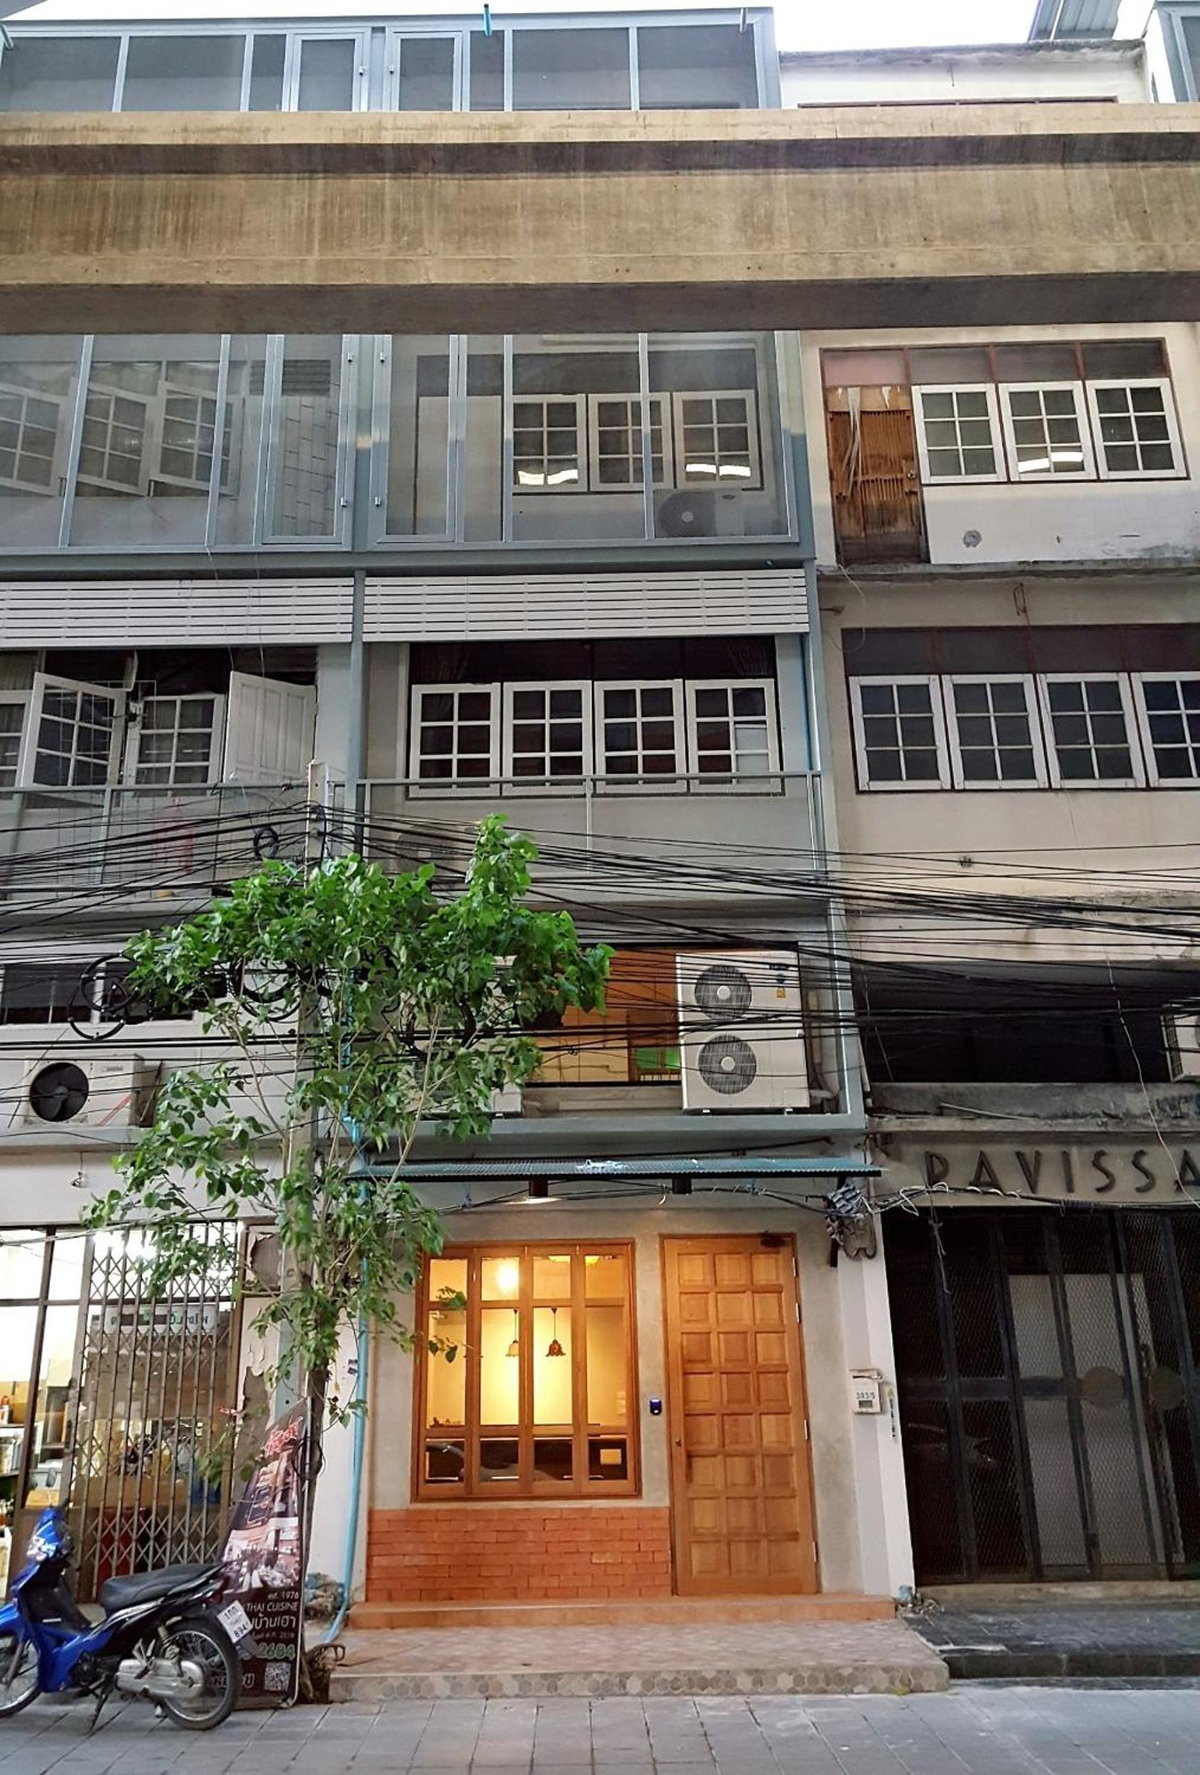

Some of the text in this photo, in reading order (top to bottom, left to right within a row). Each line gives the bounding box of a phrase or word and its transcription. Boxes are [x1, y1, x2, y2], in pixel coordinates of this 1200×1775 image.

[281, 1591, 299, 1600] 1976
[246, 1601, 299, 1612] THAI CUISINE
